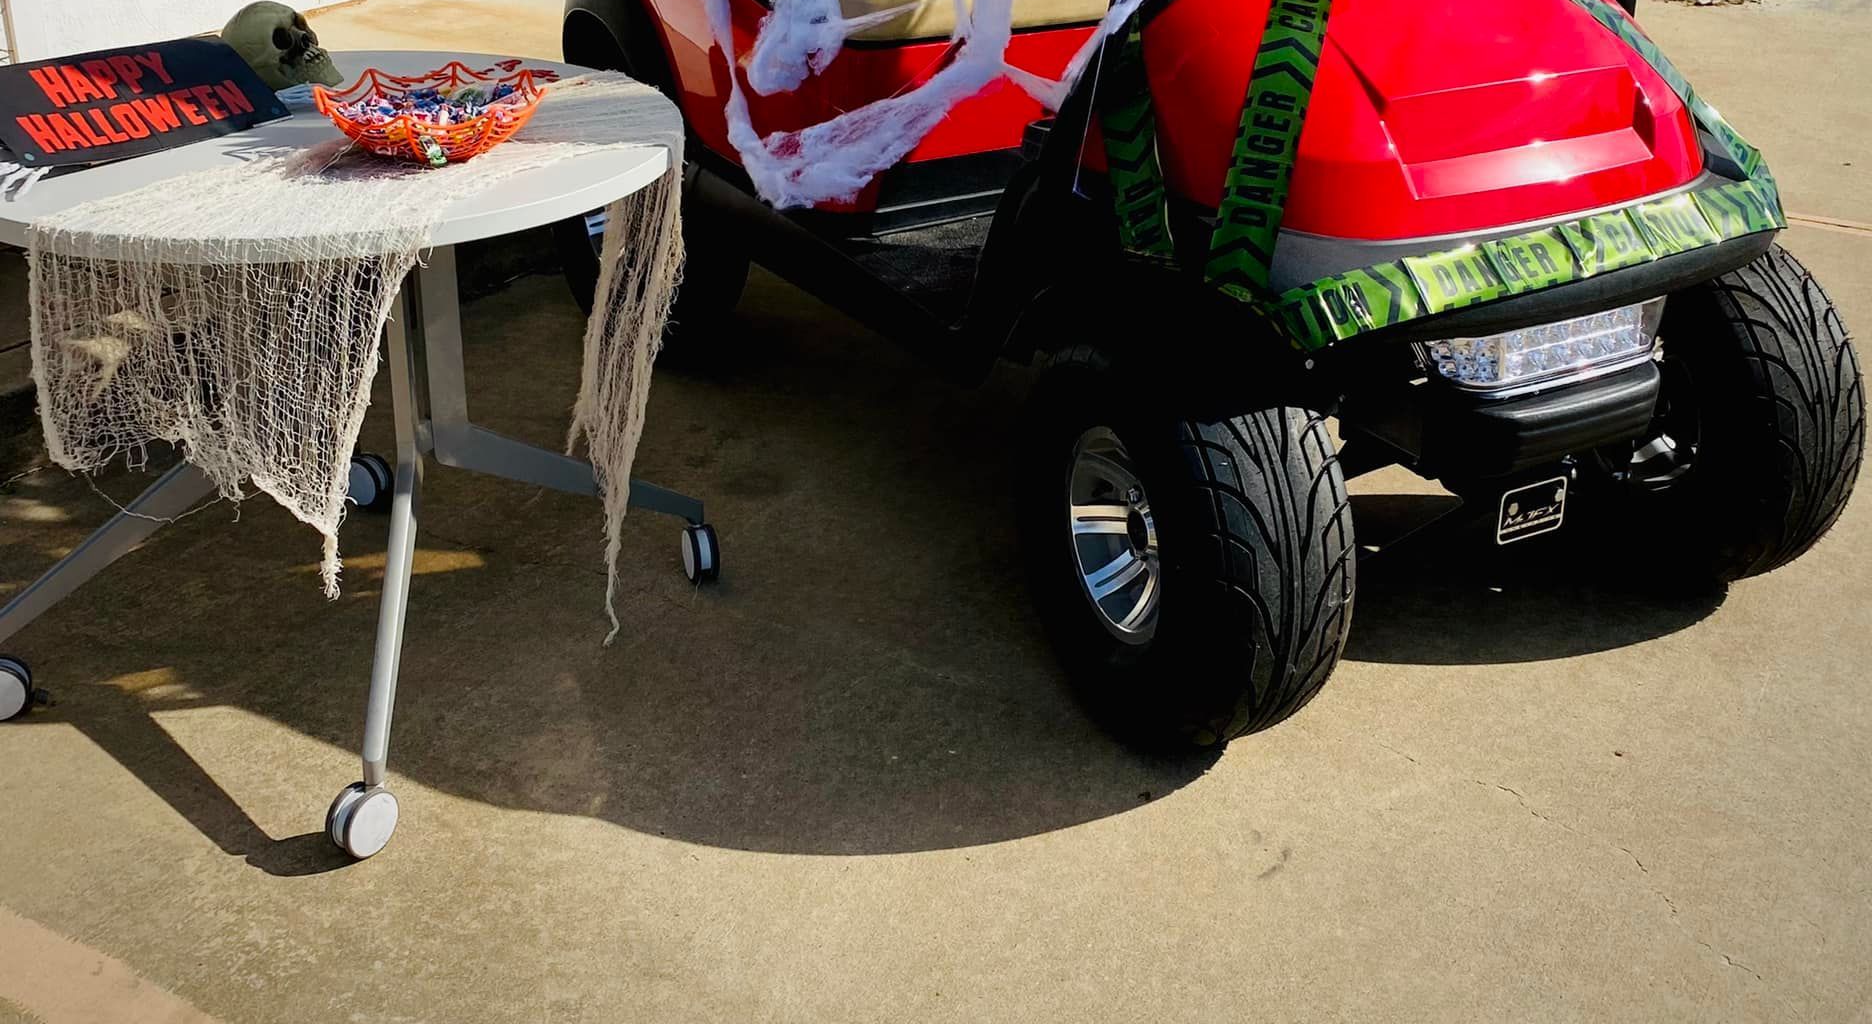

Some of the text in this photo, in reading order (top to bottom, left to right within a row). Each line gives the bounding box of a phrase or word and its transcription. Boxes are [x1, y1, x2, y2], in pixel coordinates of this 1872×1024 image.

[16, 79, 254, 154] HALLOWEEN
[29, 52, 173, 108] HAPPY
[1230, 90, 1297, 227] DANGER
